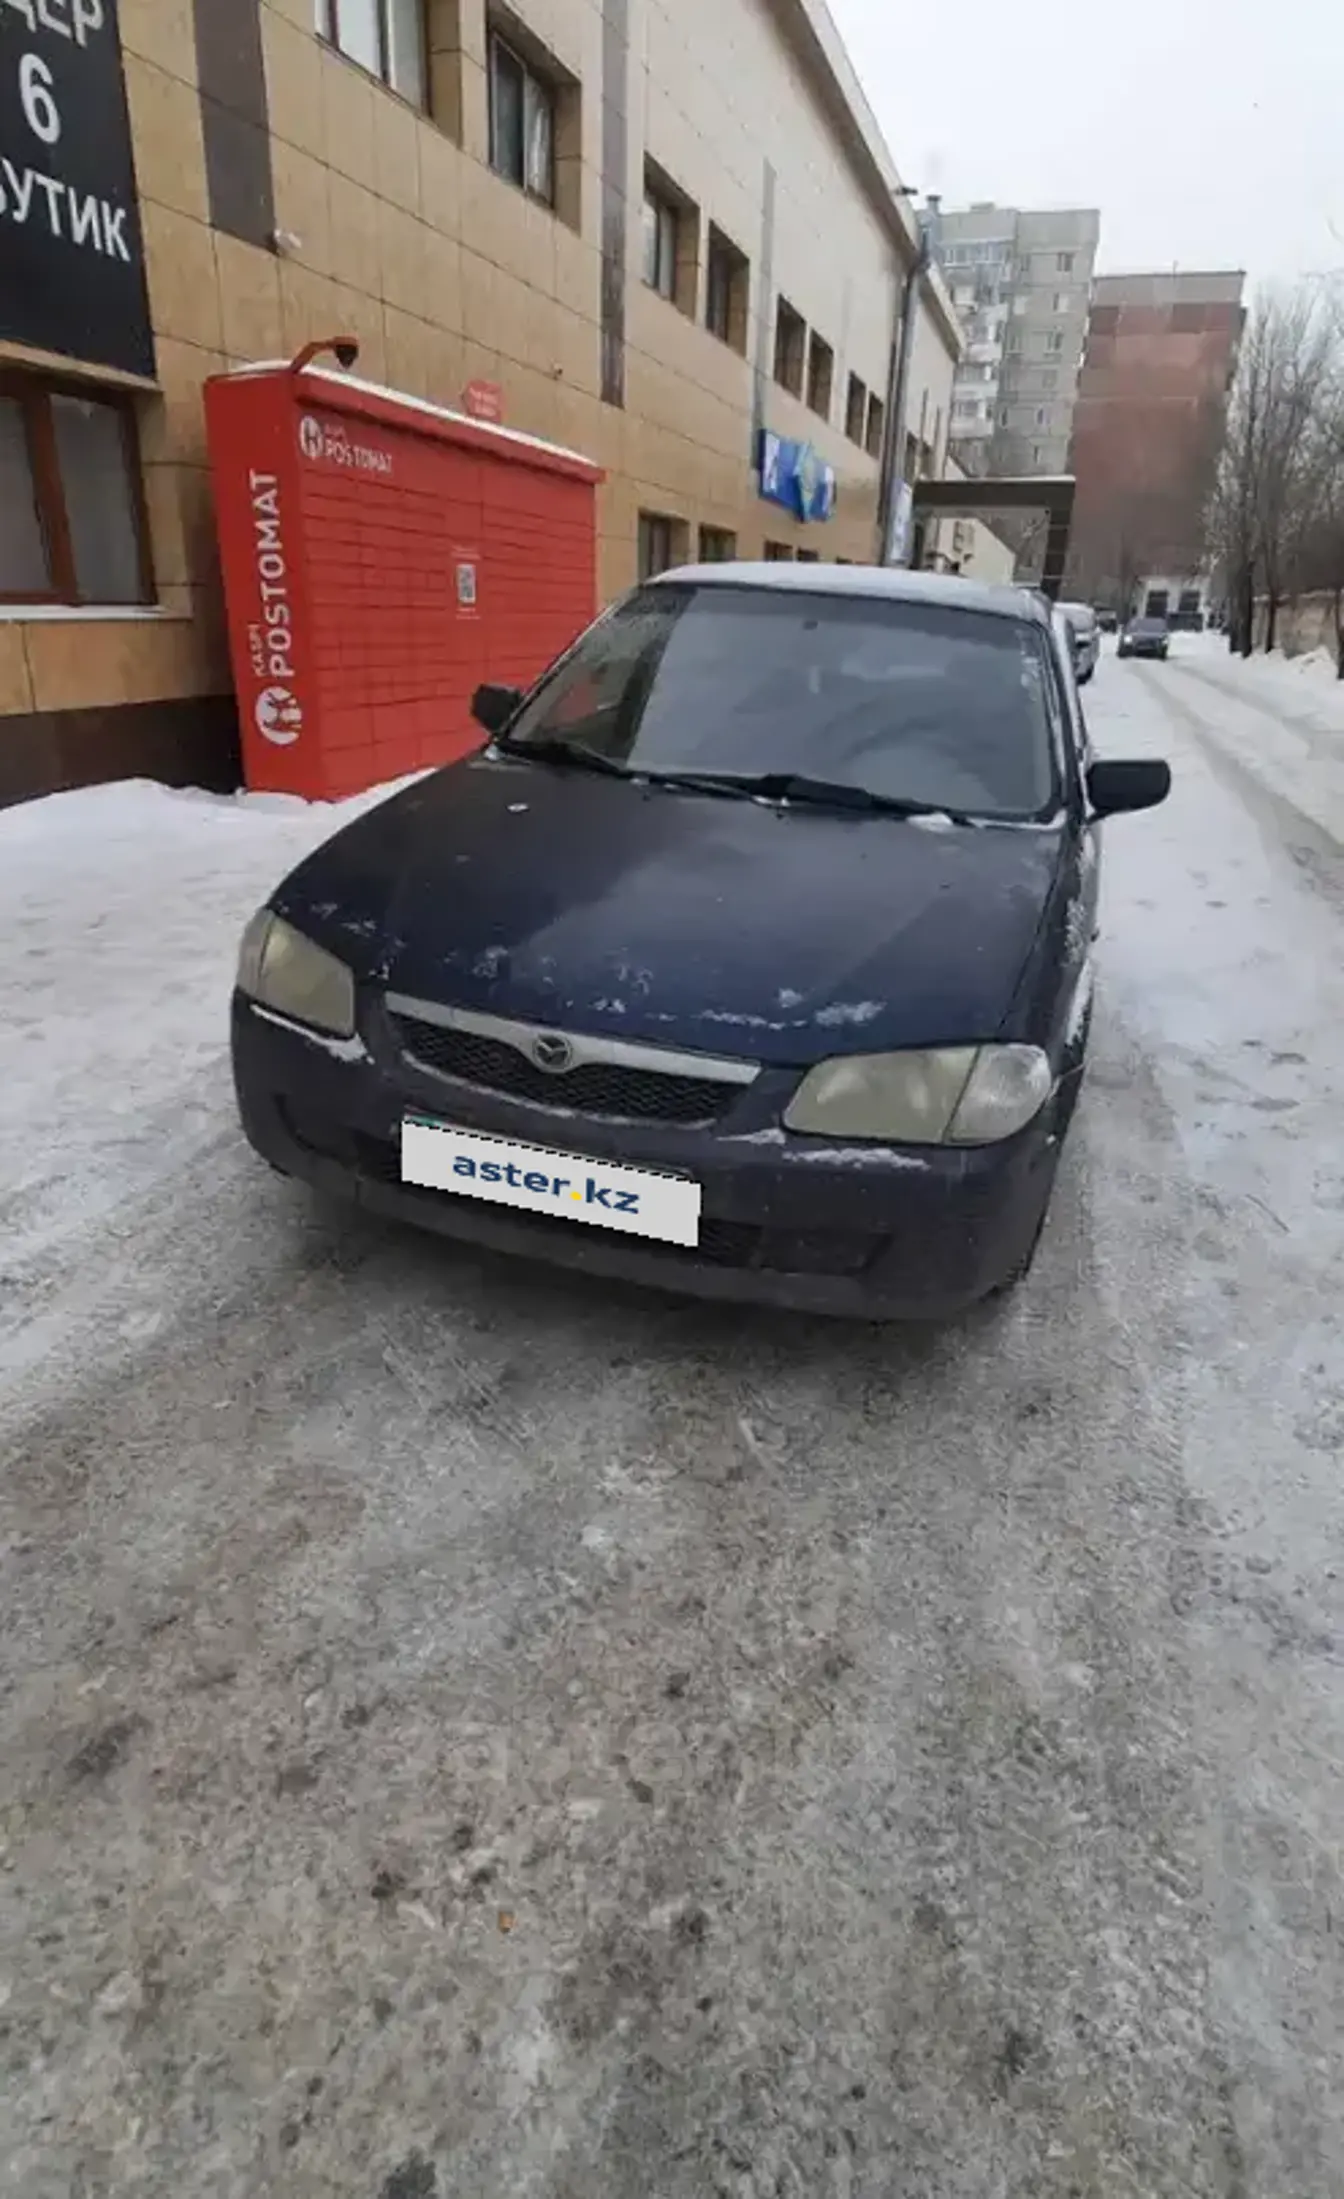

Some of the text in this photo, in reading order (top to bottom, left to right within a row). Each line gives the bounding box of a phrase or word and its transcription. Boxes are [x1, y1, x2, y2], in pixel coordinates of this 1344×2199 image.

[19, 53, 61, 143] 6
[0, 157, 131, 262] УТИК
[325, 439, 392, 474] POSTOMAT
[249, 468, 295, 678] POSTOMAT
